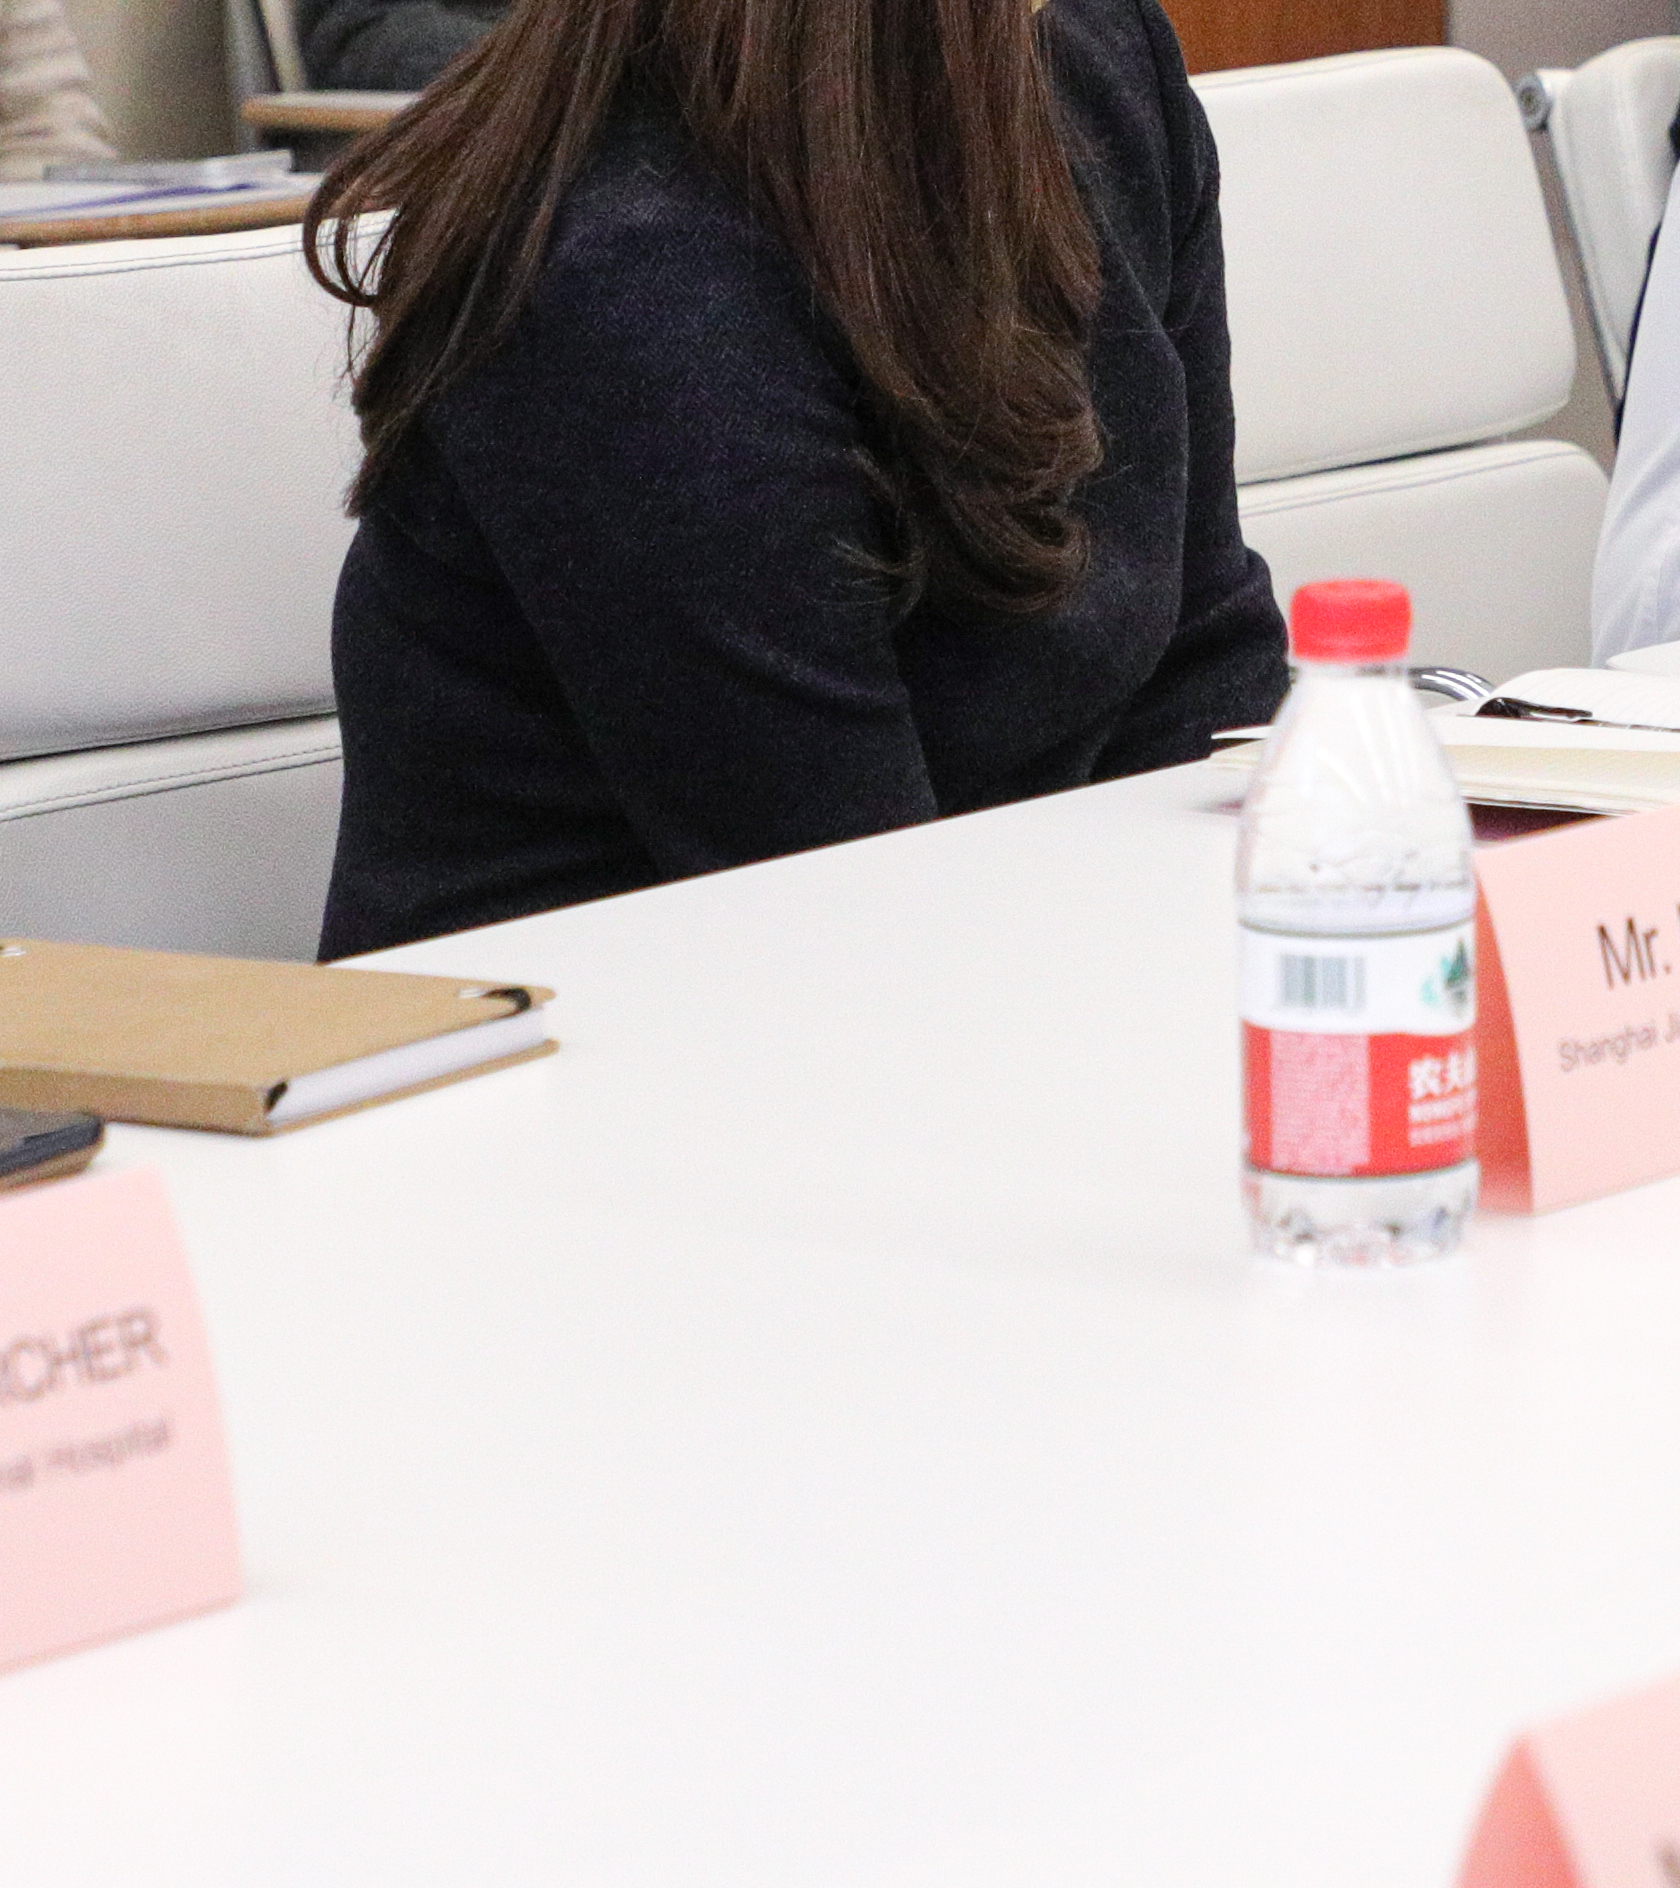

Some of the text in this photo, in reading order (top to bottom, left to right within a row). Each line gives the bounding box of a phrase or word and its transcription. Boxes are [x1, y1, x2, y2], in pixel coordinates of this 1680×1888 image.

[1596, 917, 1671, 989] Mr.
[1556, 1019, 1658, 1073] Shanghai
[44, 1414, 175, 1474] Hospital
